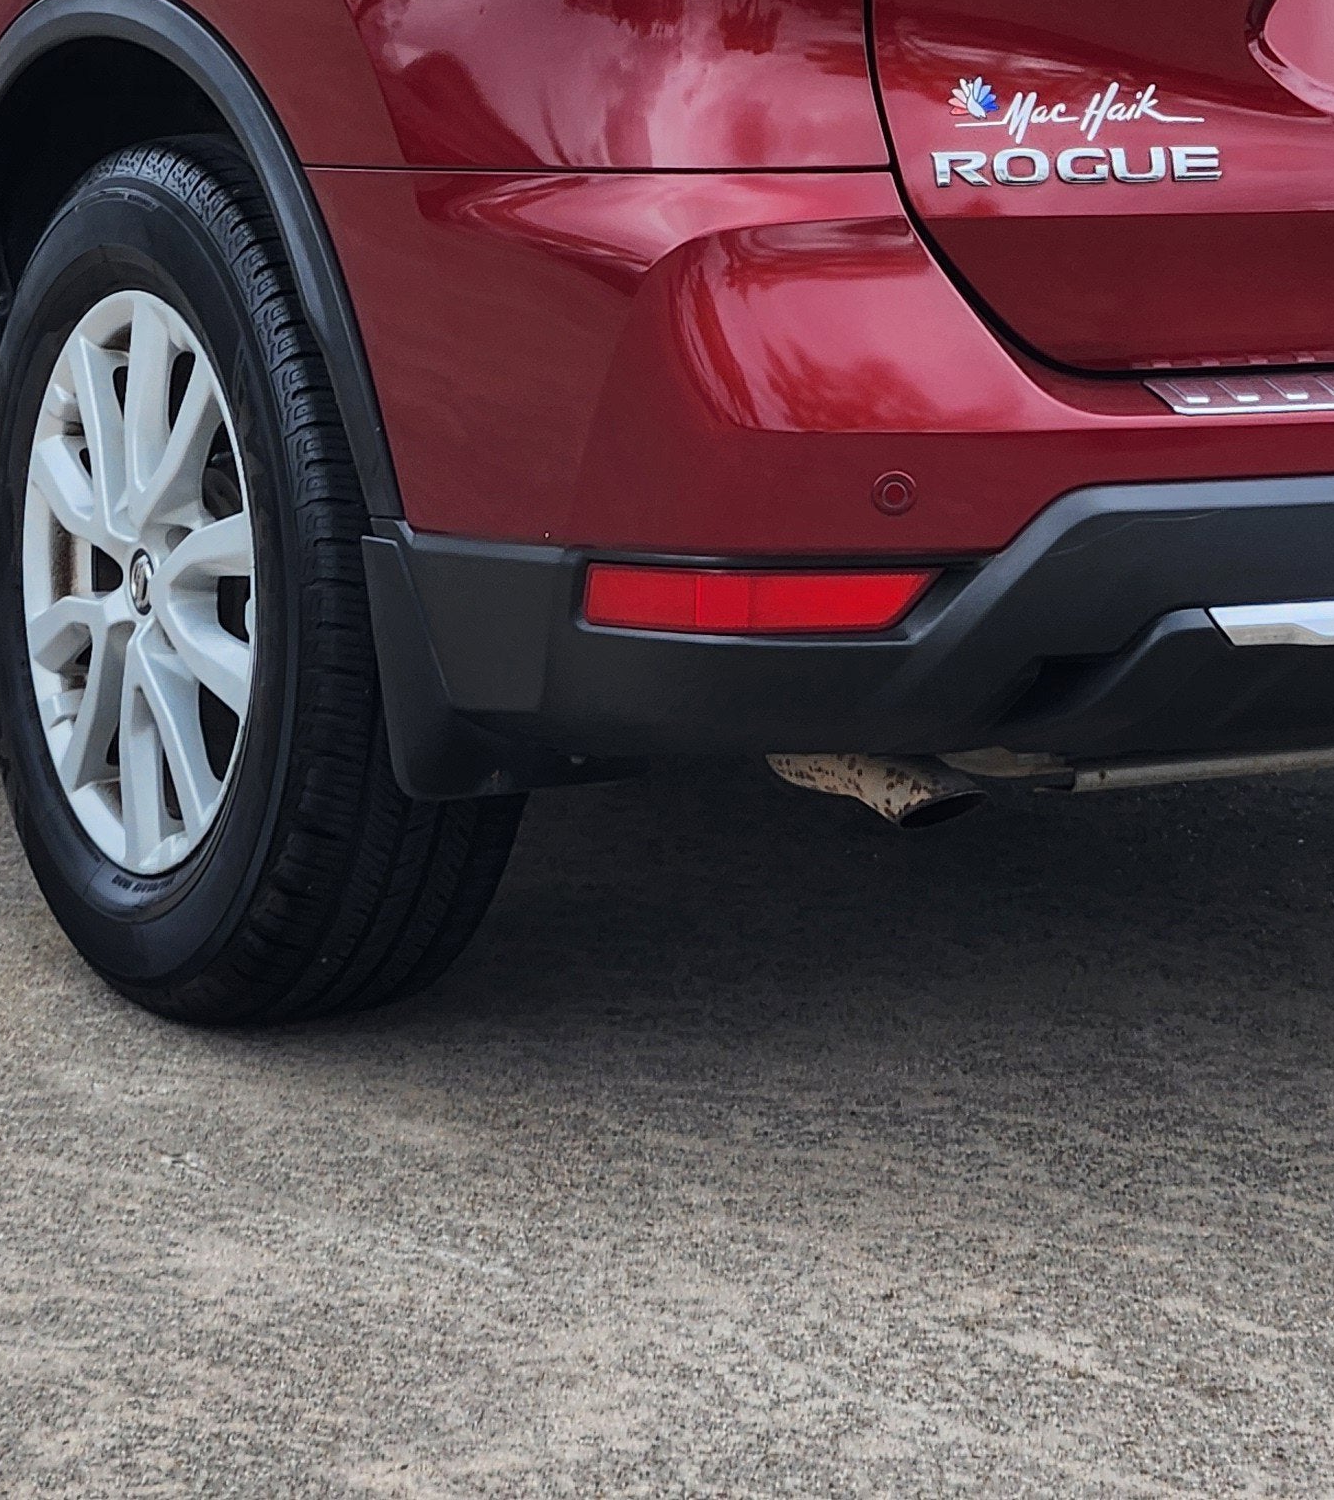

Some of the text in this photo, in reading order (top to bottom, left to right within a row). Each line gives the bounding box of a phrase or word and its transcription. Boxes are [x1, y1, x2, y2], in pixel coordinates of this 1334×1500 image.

[992, 81, 1175, 144] Mac Haik
[930, 146, 1223, 188] ROGUE
